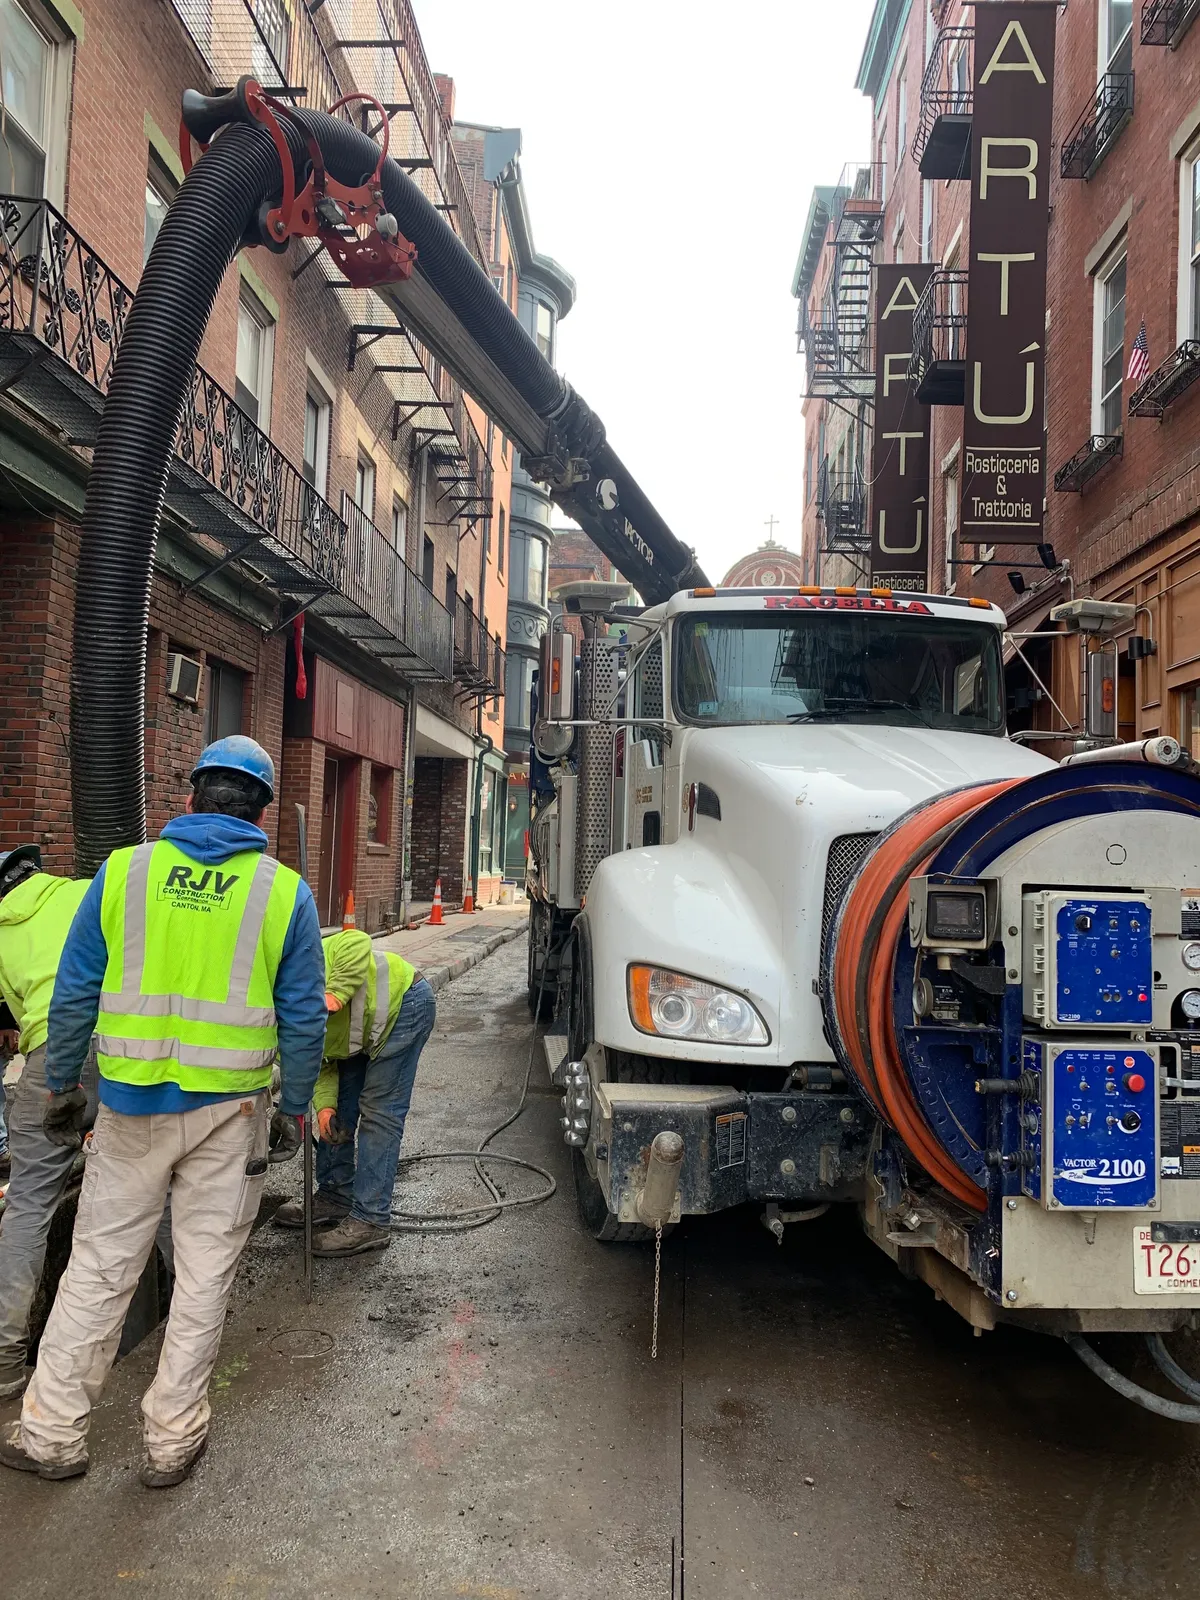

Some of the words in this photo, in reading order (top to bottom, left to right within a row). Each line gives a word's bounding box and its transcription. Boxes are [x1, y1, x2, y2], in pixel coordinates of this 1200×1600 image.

[965, 452, 1040, 475] Rosticceria
[996, 475, 1007, 495] &
[971, 497, 1032, 518] Trattoria
[872, 575, 925, 590] Rosticceria
[763, 596, 935, 615] PACELLA
[165, 865, 241, 894] RJV
[162, 887, 226, 902] CONSTRUCTION
[171, 901, 200, 912] CANTON,
[1062, 1158, 1097, 1168] VACTOR
[1098, 1158, 1146, 1177] 2100
[1140, 1231, 1151, 1240] DE
[1167, 1279, 1200, 1288] COMME
